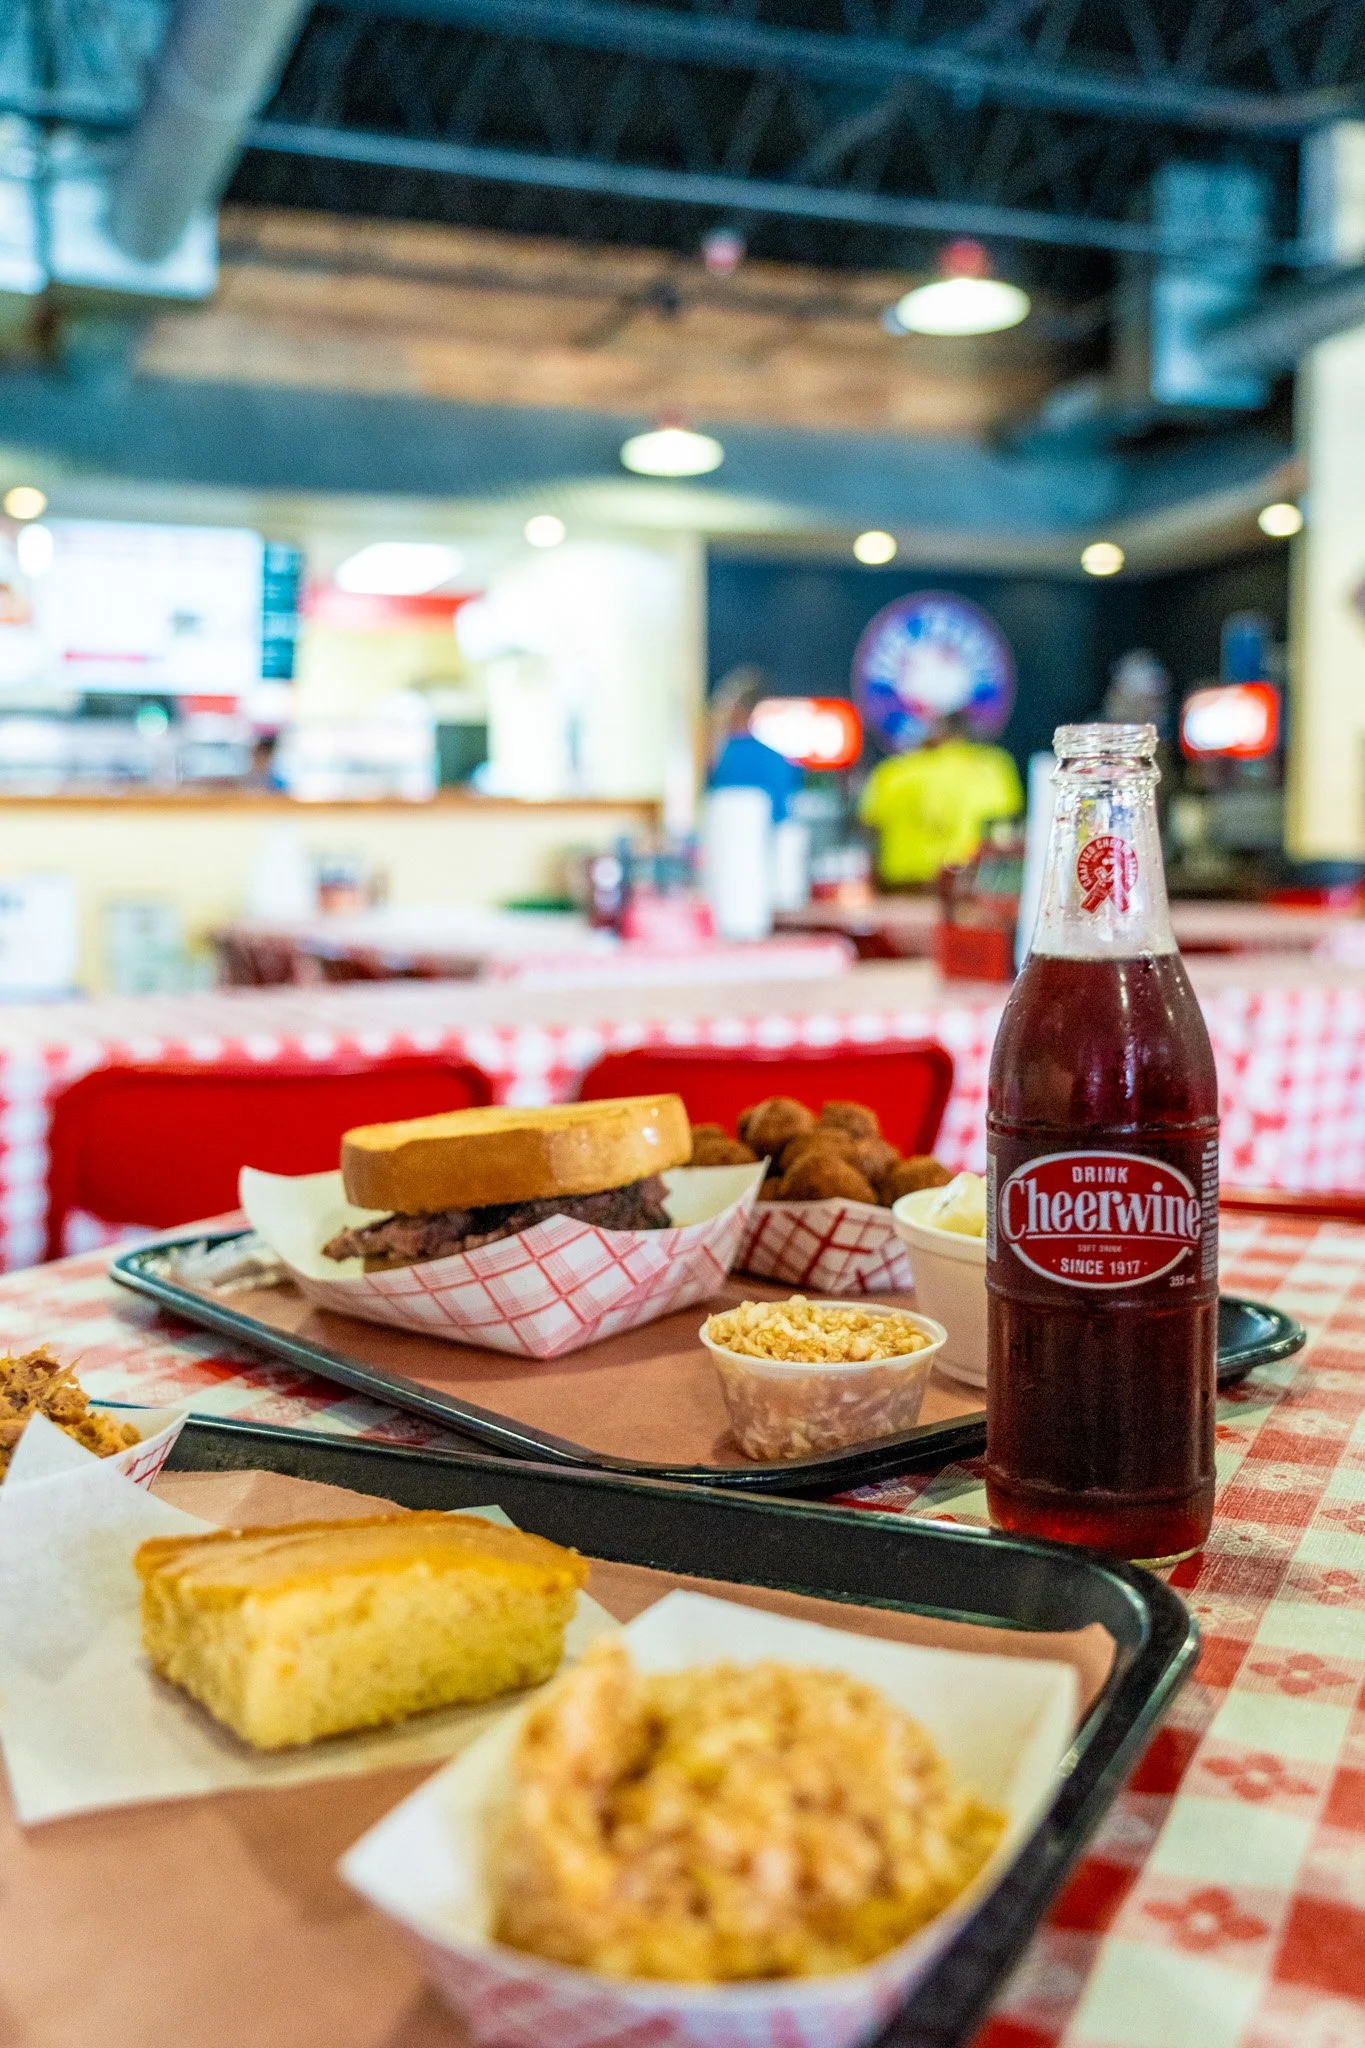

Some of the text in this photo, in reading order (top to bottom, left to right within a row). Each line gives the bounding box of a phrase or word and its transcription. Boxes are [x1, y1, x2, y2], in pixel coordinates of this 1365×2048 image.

[1079, 846, 1095, 887] CRAFTED
[1072, 1166, 1129, 1183] DRINK
[1002, 1177, 1200, 1240] Cheerwine
[1077, 1244, 1096, 1252] SOFT
[1060, 1257, 1140, 1275] SINCE 1917
[1169, 1275, 1185, 1288] 355
